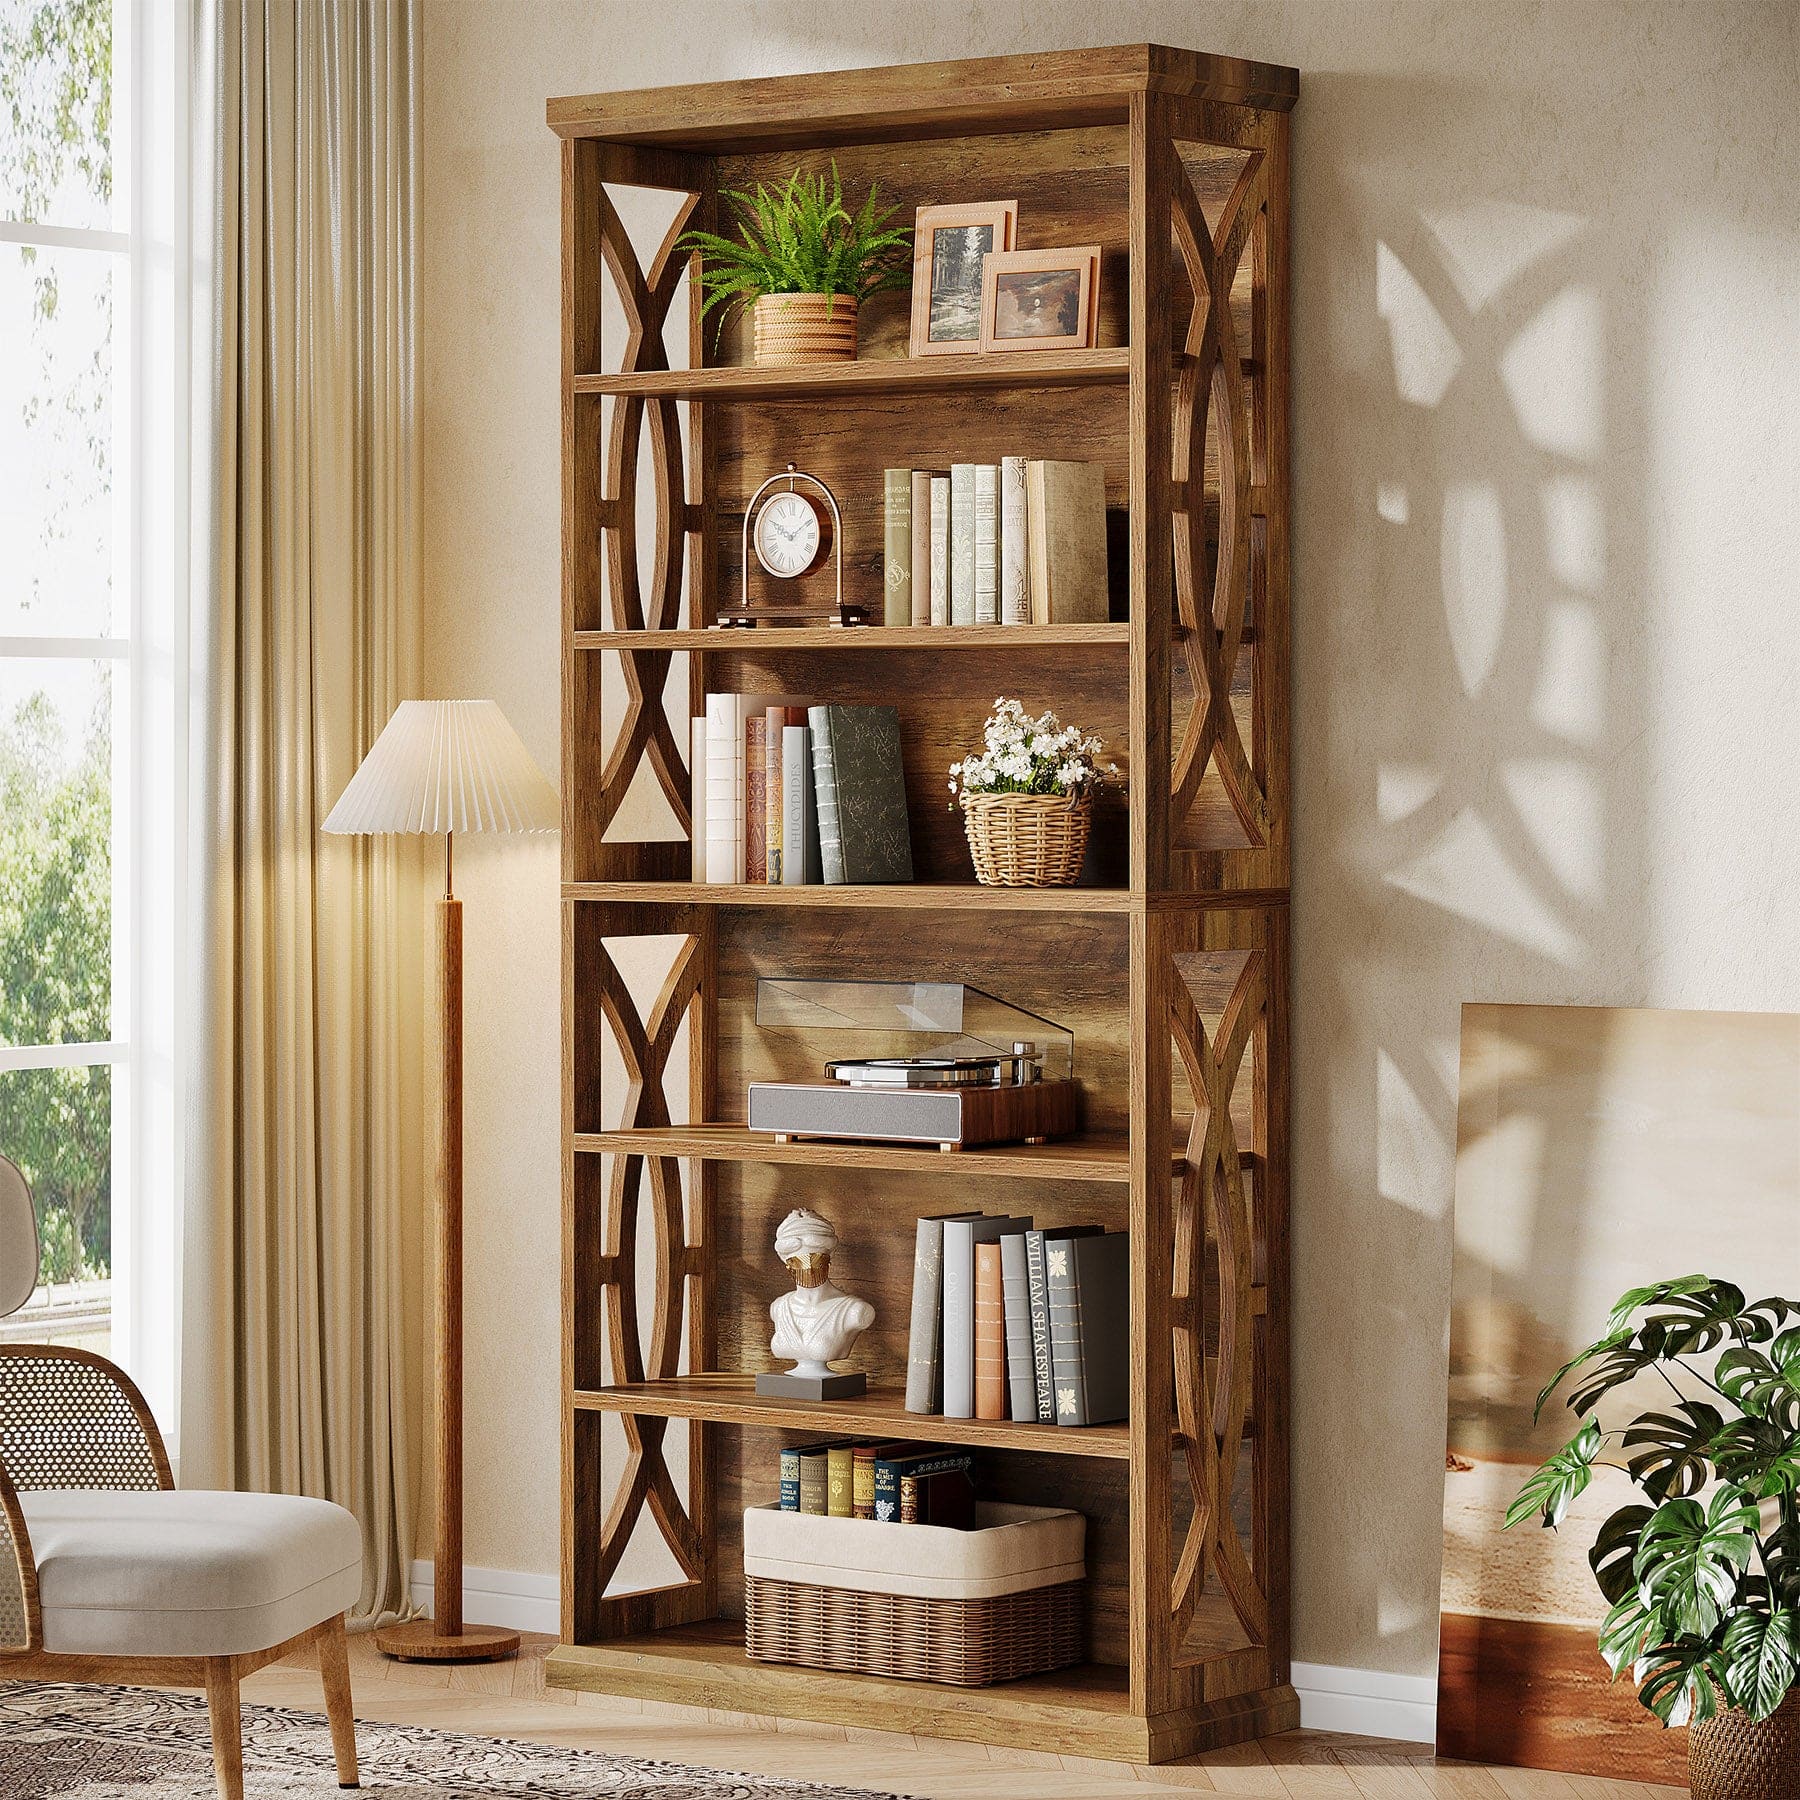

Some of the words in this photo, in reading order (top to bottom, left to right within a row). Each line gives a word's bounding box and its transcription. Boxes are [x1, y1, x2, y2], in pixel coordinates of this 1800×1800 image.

[790, 763, 801, 853] THUCYDIDES
[1027, 1235, 1044, 1307] WILLIAM
[1033, 1311, 1052, 1420] SHAKESPEARE
